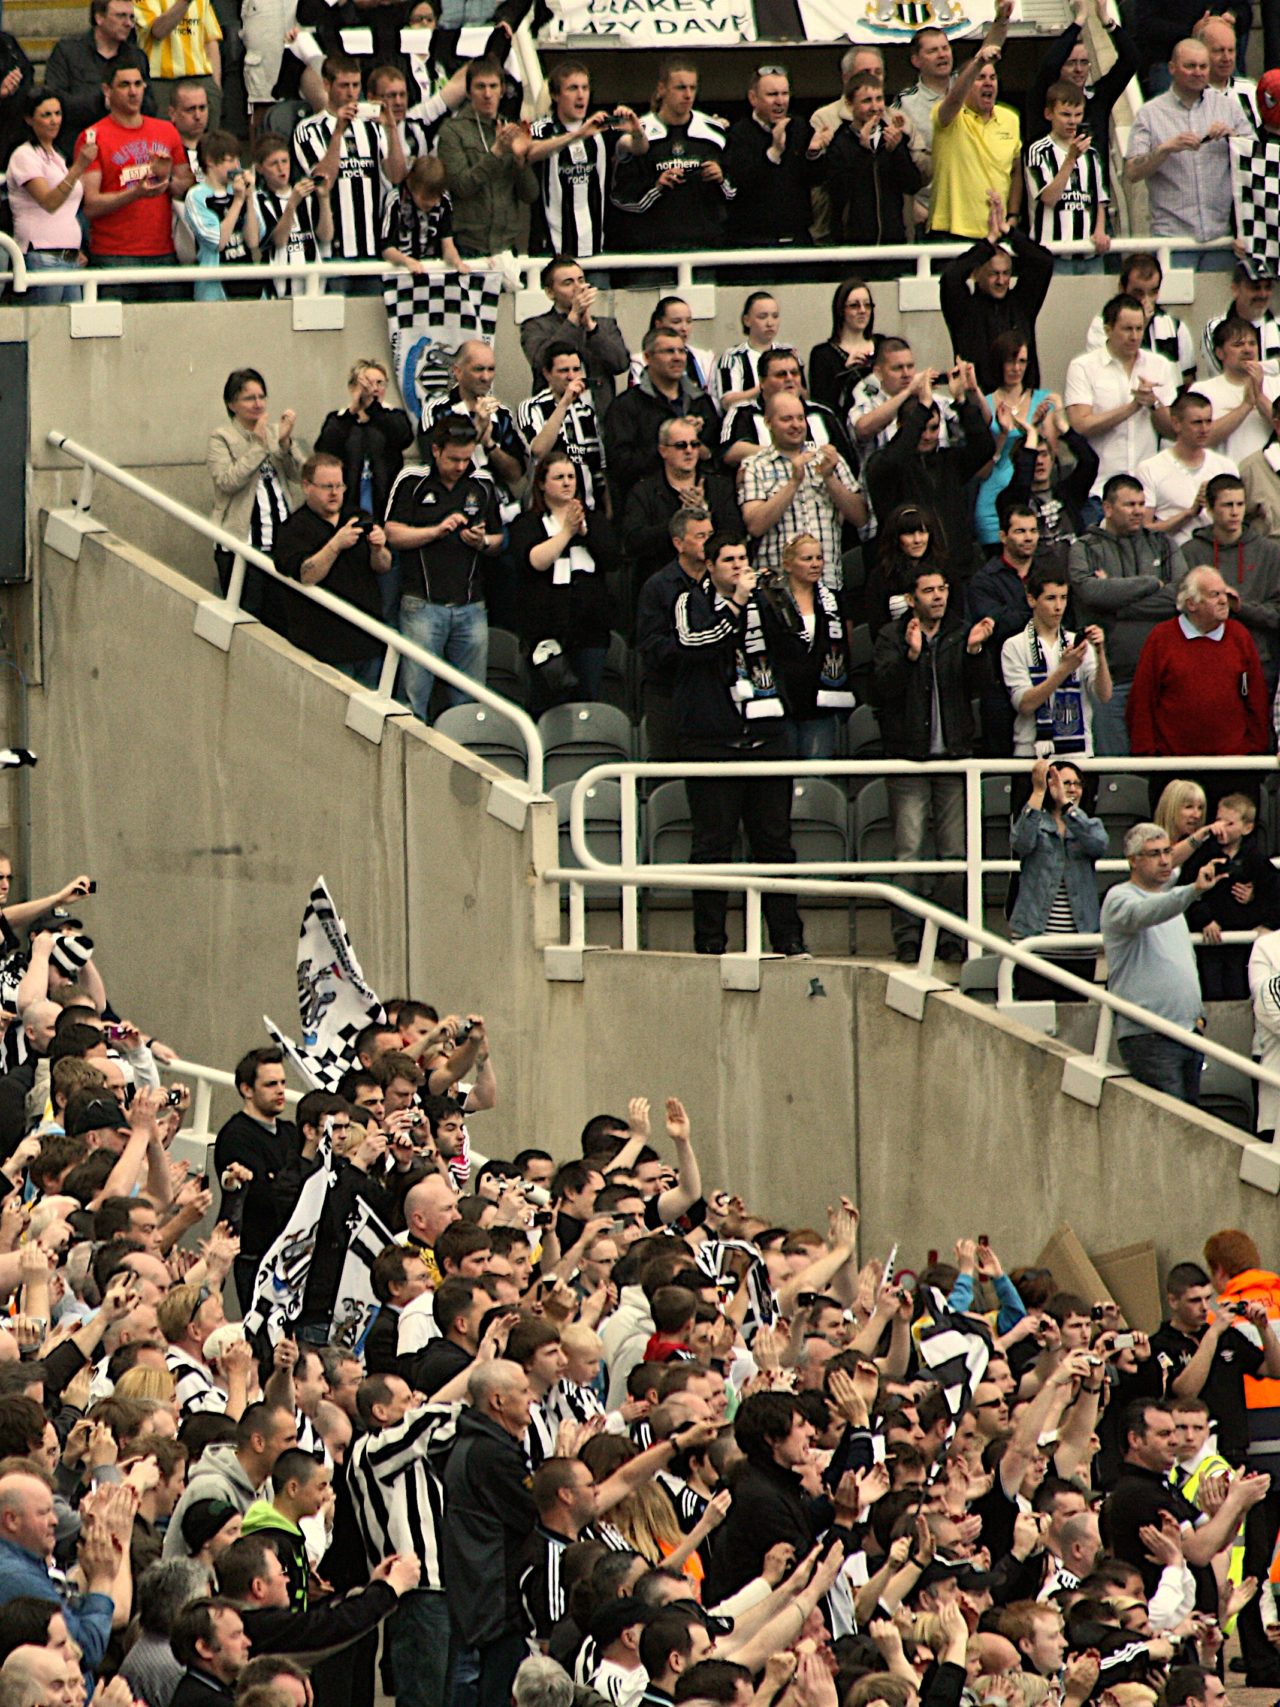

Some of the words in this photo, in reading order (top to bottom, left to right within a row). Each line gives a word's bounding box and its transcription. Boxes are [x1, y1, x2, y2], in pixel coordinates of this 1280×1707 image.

[339, 158, 375, 169] orthern
[558, 162, 597, 176] norther
[656, 158, 700, 172] northern
[568, 174, 590, 185] rock
[1061, 190, 1092, 203] orthern
